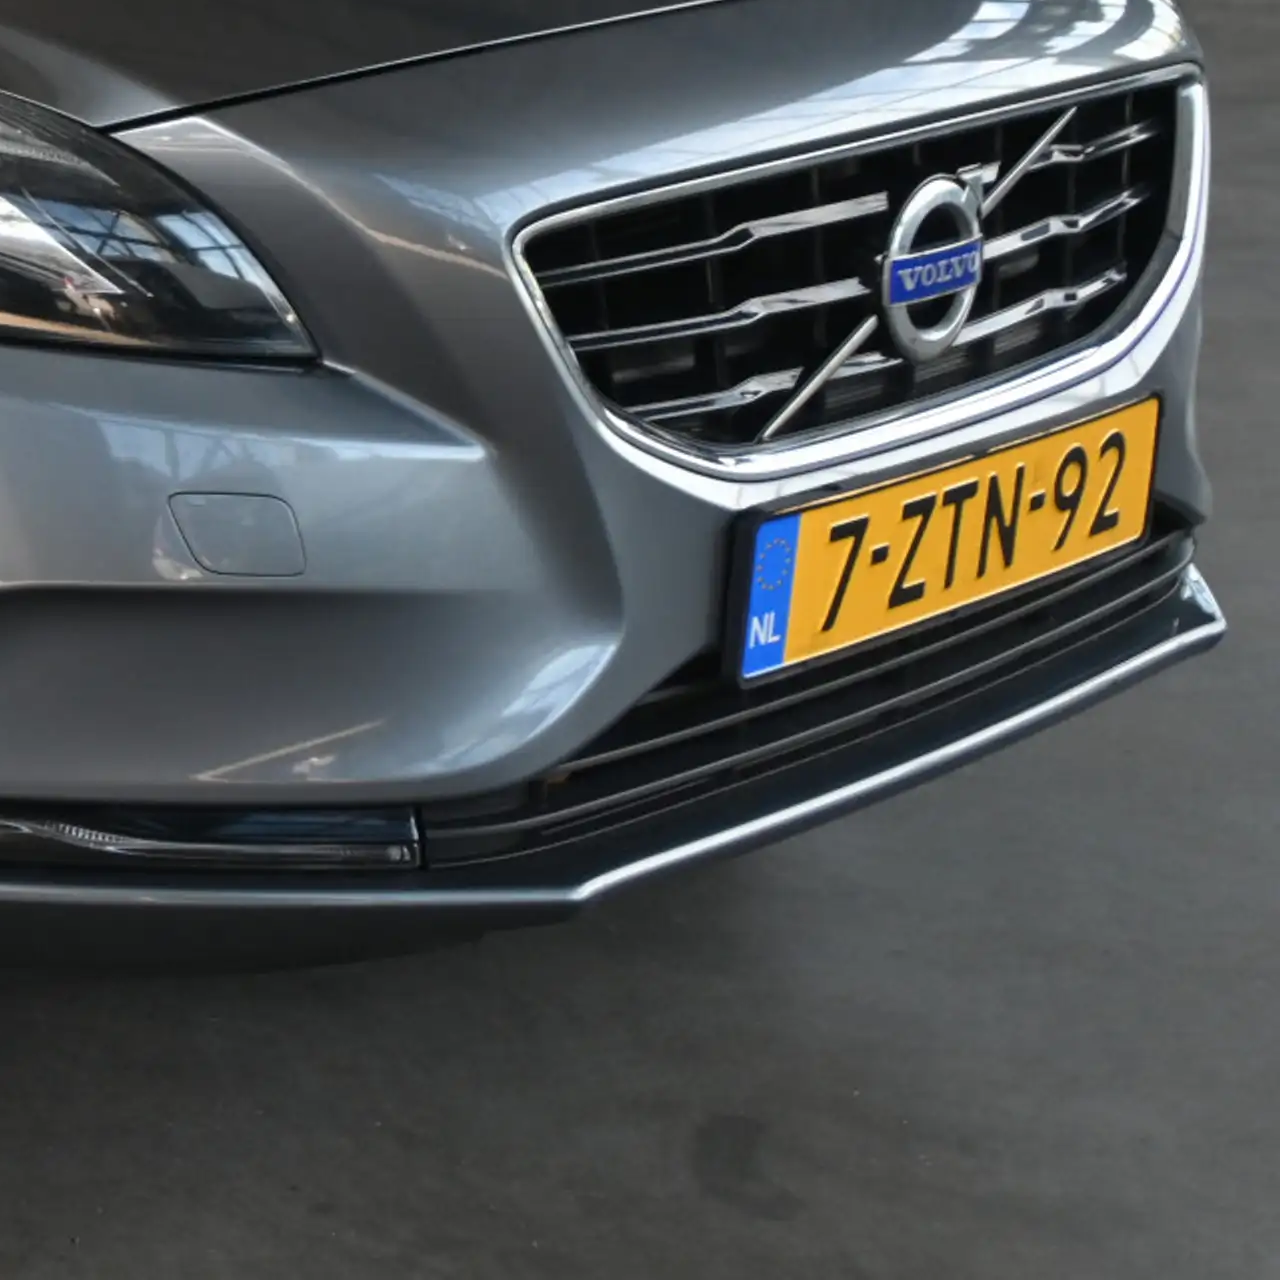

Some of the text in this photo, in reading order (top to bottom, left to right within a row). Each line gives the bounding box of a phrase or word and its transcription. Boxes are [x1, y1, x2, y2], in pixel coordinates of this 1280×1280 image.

[898, 251, 981, 291] VOLVO
[819, 428, 1127, 632] 7-ZTN-92
[749, 612, 781, 648] NL
